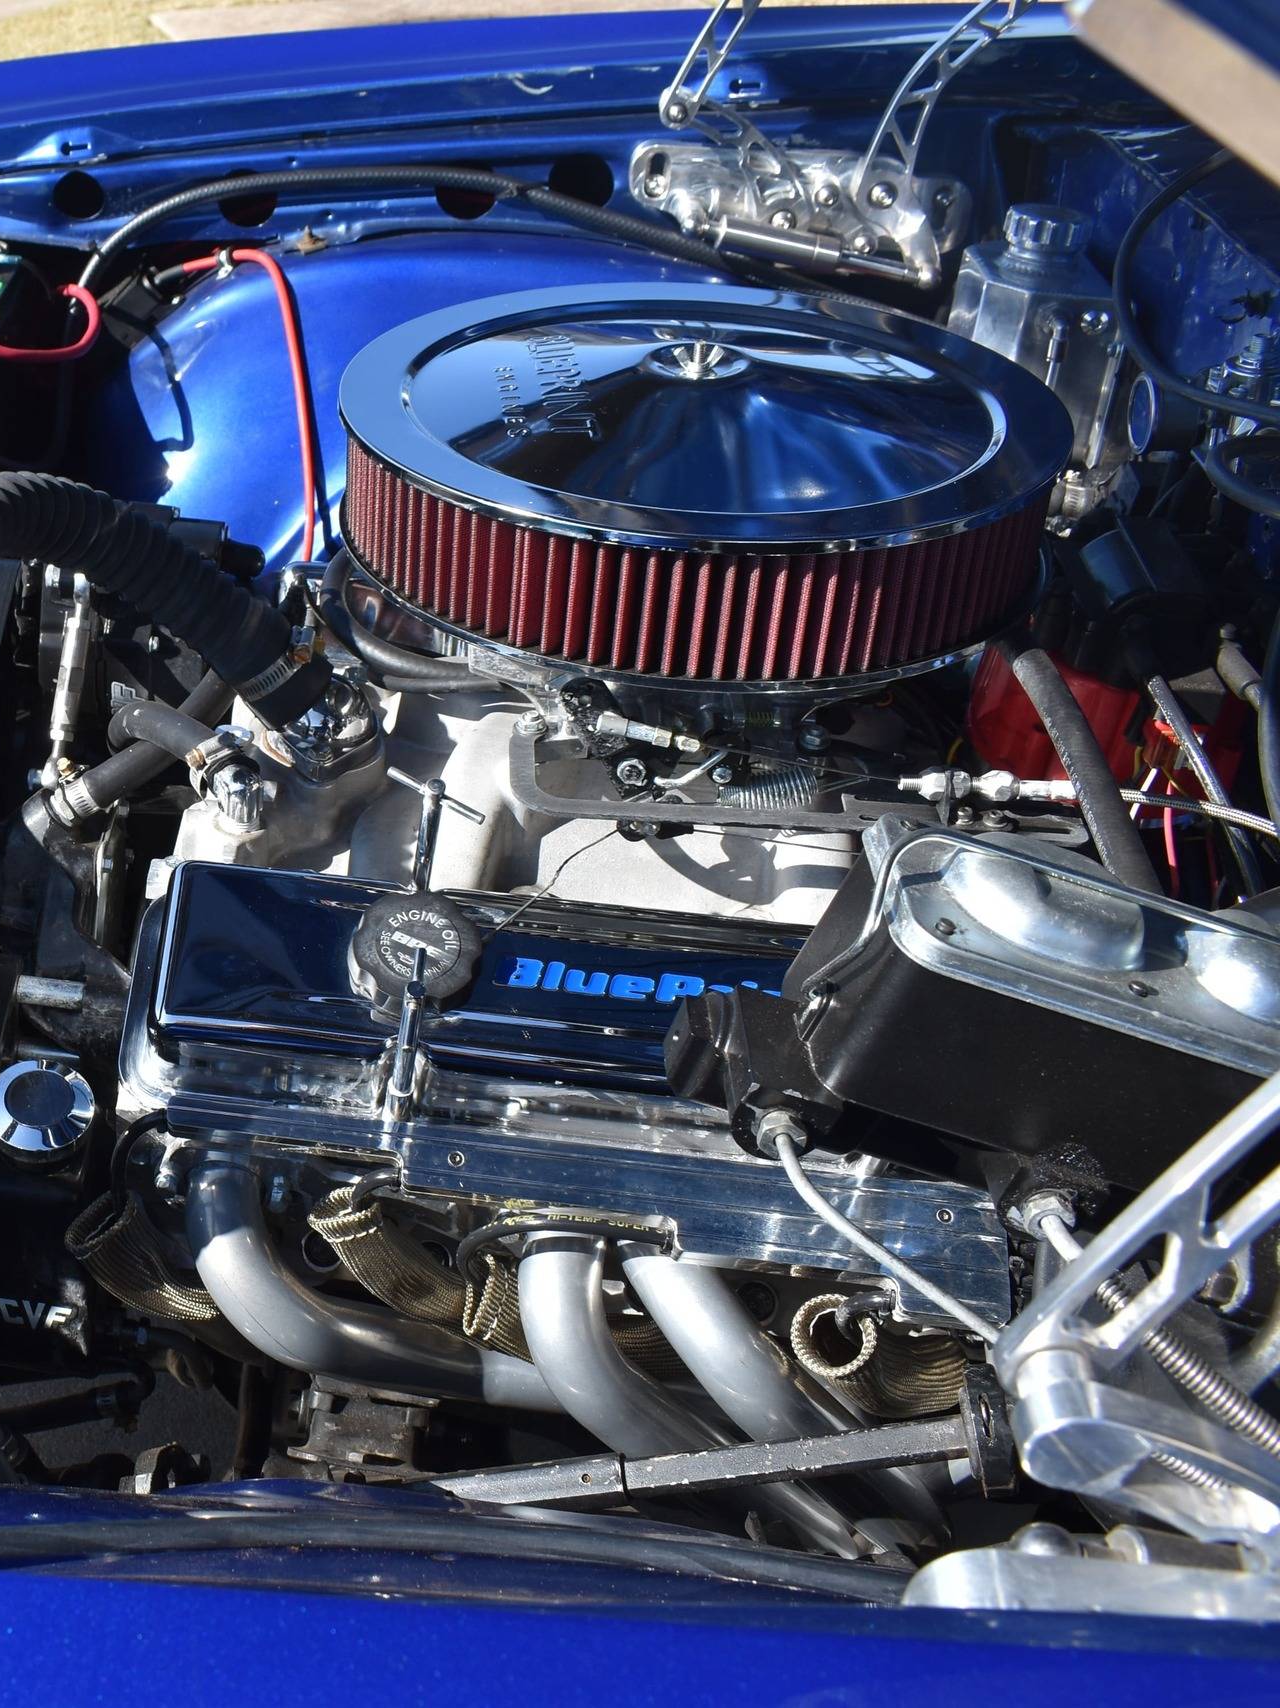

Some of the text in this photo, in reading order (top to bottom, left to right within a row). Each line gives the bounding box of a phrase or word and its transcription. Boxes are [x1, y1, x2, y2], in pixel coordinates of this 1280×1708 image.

[388, 909, 458, 951] ENGINE OIL
[380, 930, 452, 977] SEE OWNERS ANUAL
